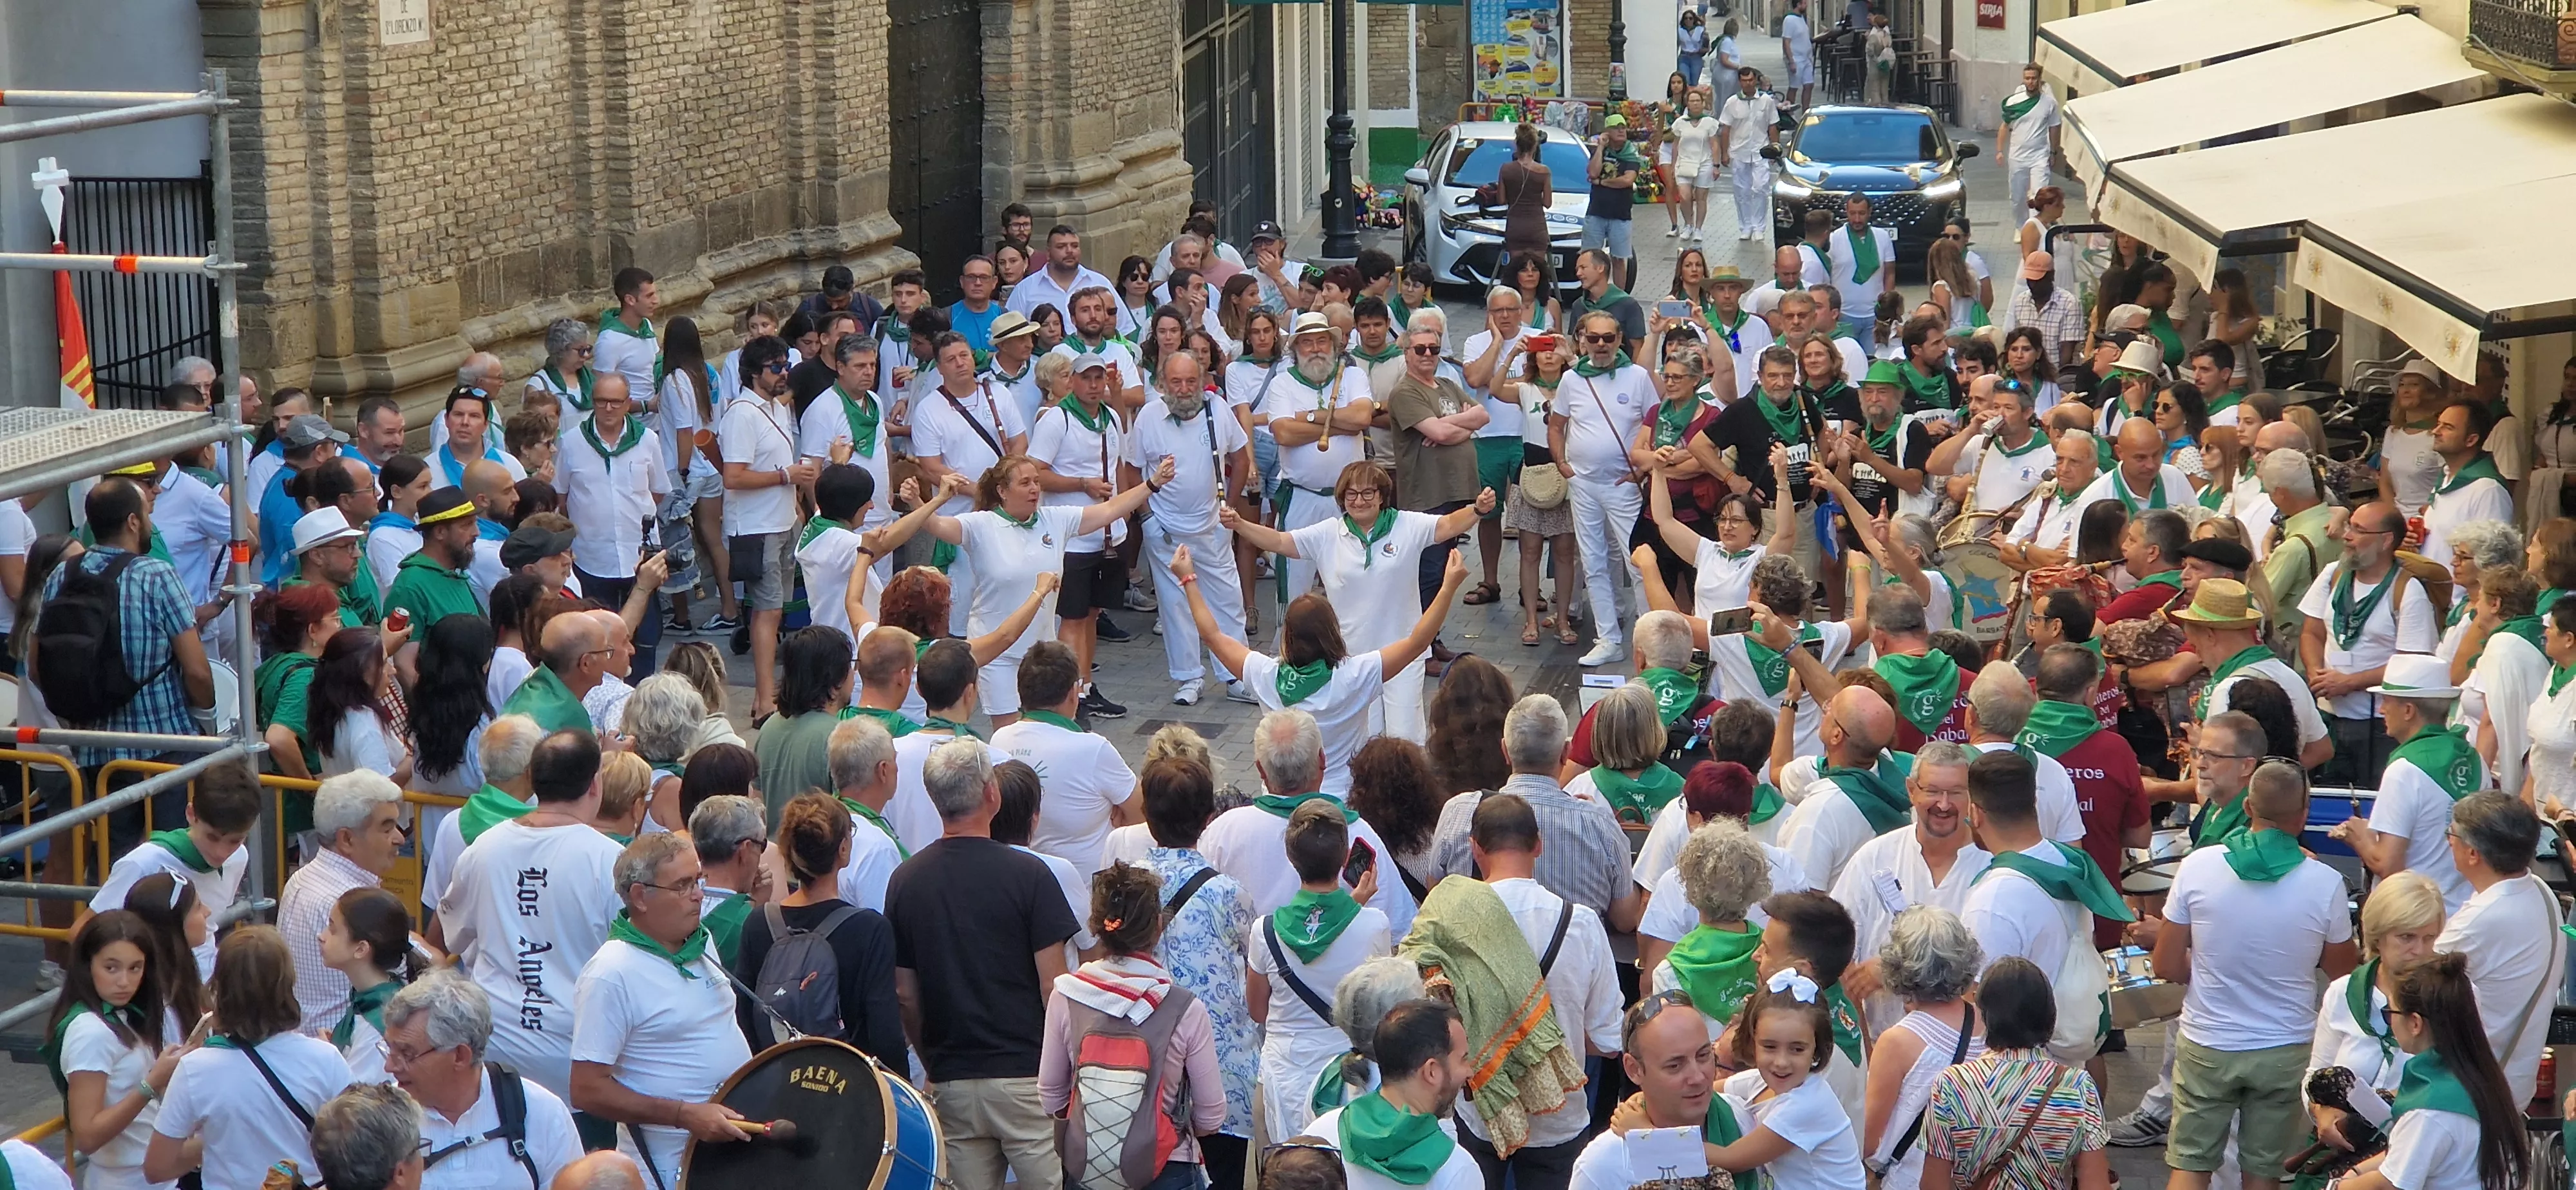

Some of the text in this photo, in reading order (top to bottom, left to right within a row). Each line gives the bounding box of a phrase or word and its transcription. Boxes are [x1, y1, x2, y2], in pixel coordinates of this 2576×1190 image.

[1979, 3, 2003, 18] SIRIA
[392, 17, 417, 34] LORENZO
[515, 867, 554, 1031] Los Angeles
[790, 1065, 847, 1095] BAENA
[800, 1081, 829, 1093] SONIDO
